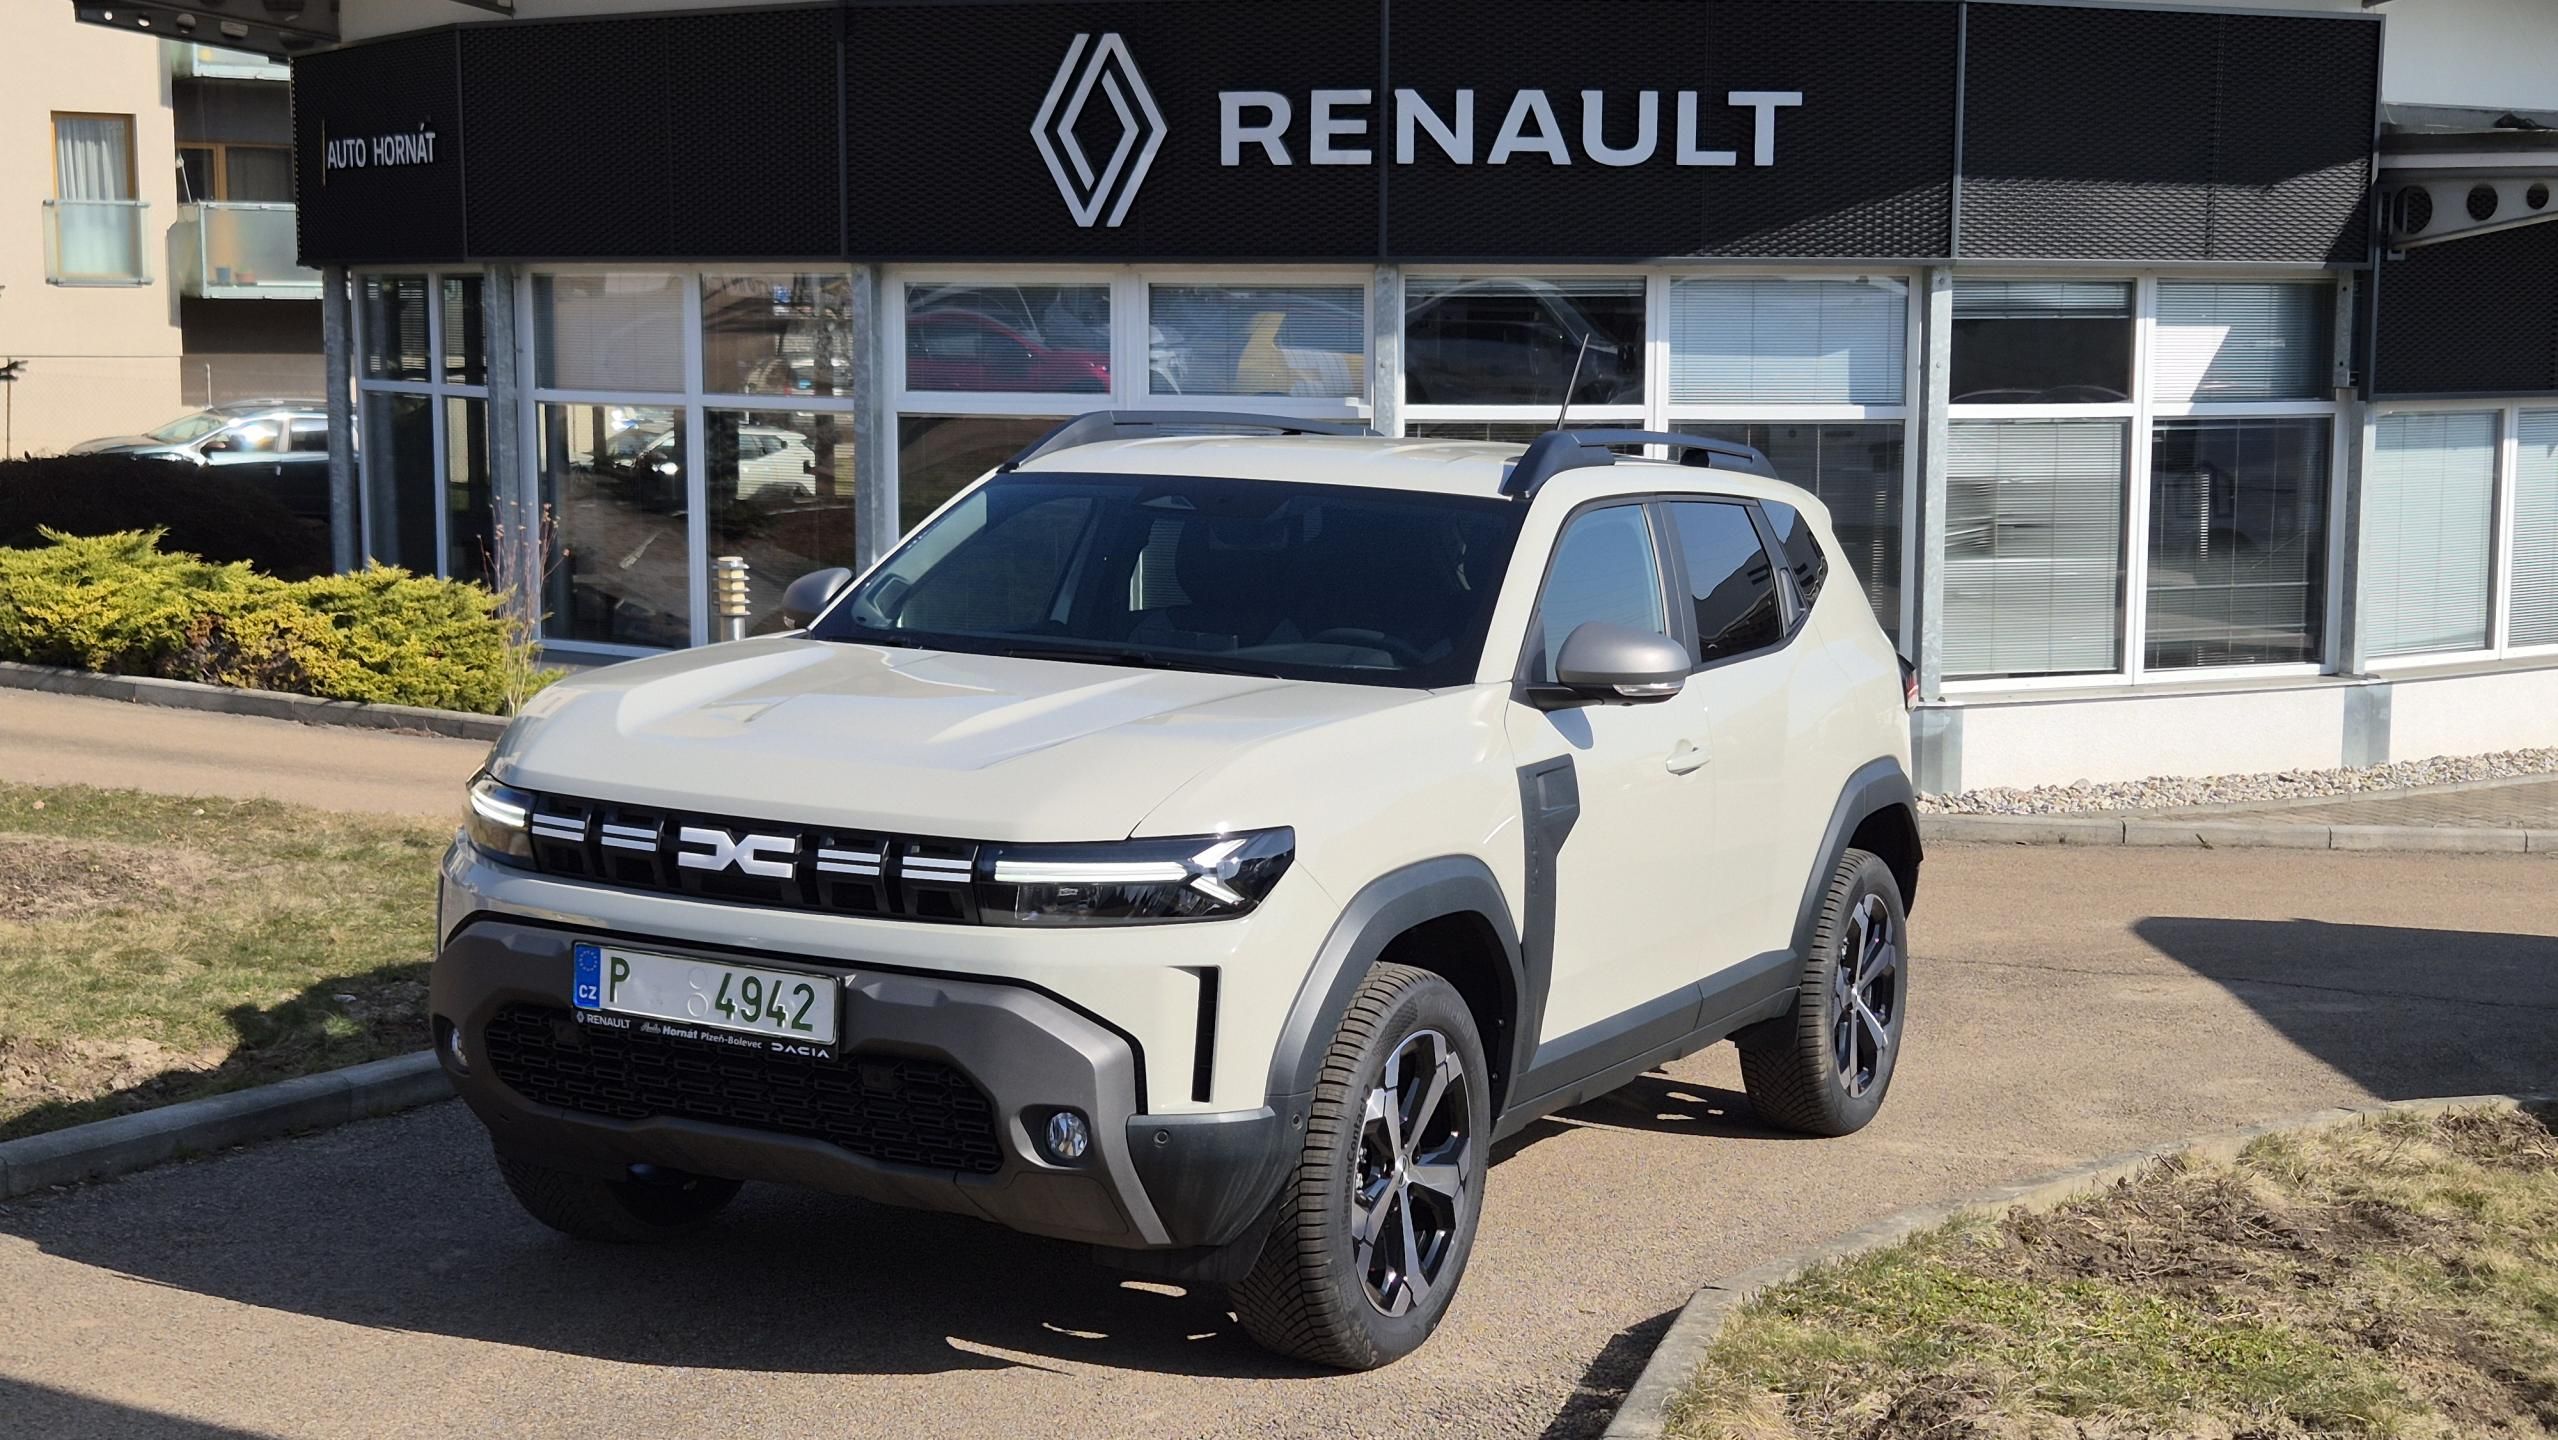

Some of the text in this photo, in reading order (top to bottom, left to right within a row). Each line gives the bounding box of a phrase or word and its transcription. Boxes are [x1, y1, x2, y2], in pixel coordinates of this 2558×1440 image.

[1218, 88, 1802, 166] RENAULT
[327, 122, 436, 169] AUTO HORNÁT
[578, 985, 597, 1000] CZ
[609, 956, 816, 1032] P 4942
[586, 1013, 632, 1029] RENAULT
[700, 1031, 763, 1049] Plzeň-Bolevec
[770, 1042, 831, 1059] DACIA
